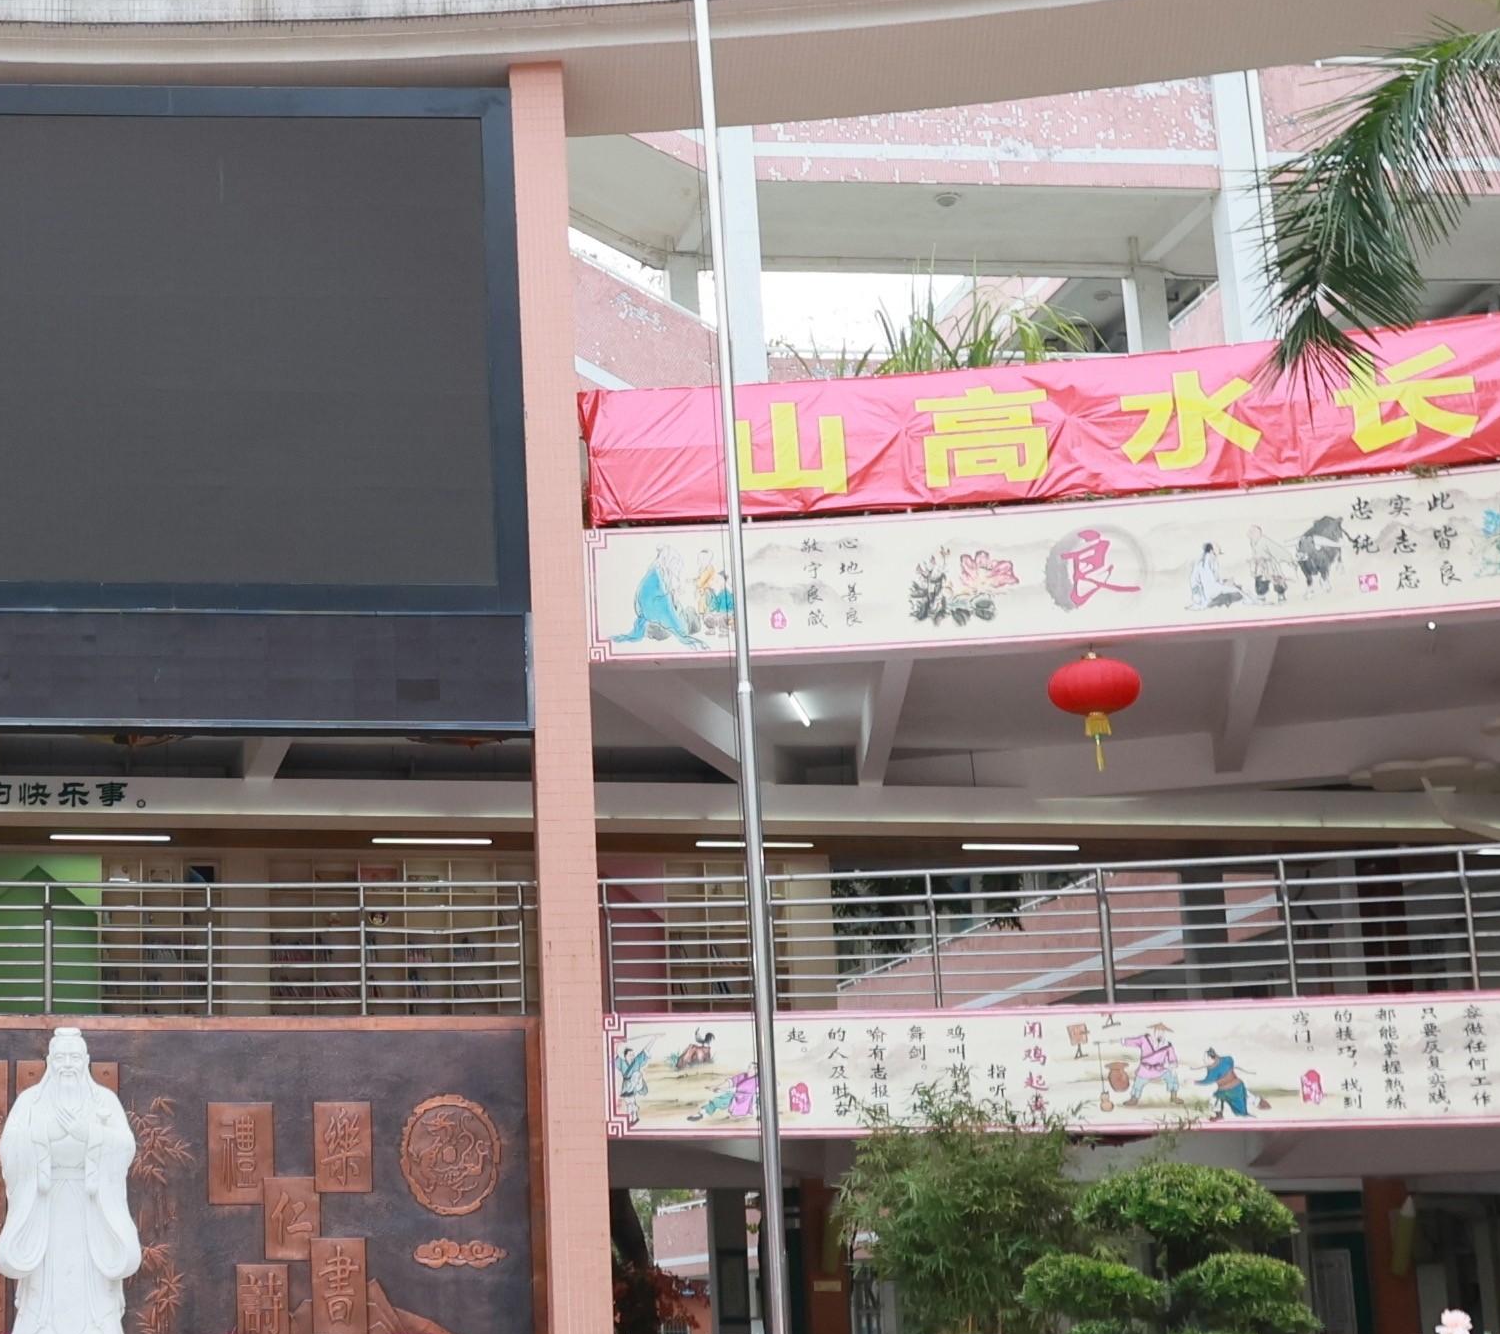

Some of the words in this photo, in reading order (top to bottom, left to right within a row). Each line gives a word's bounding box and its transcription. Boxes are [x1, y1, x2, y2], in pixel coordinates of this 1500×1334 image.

[734, 344, 1480, 496] 山高水长
[1067, 528, 1142, 607] 良
[271, 1191, 314, 1246] 仁
